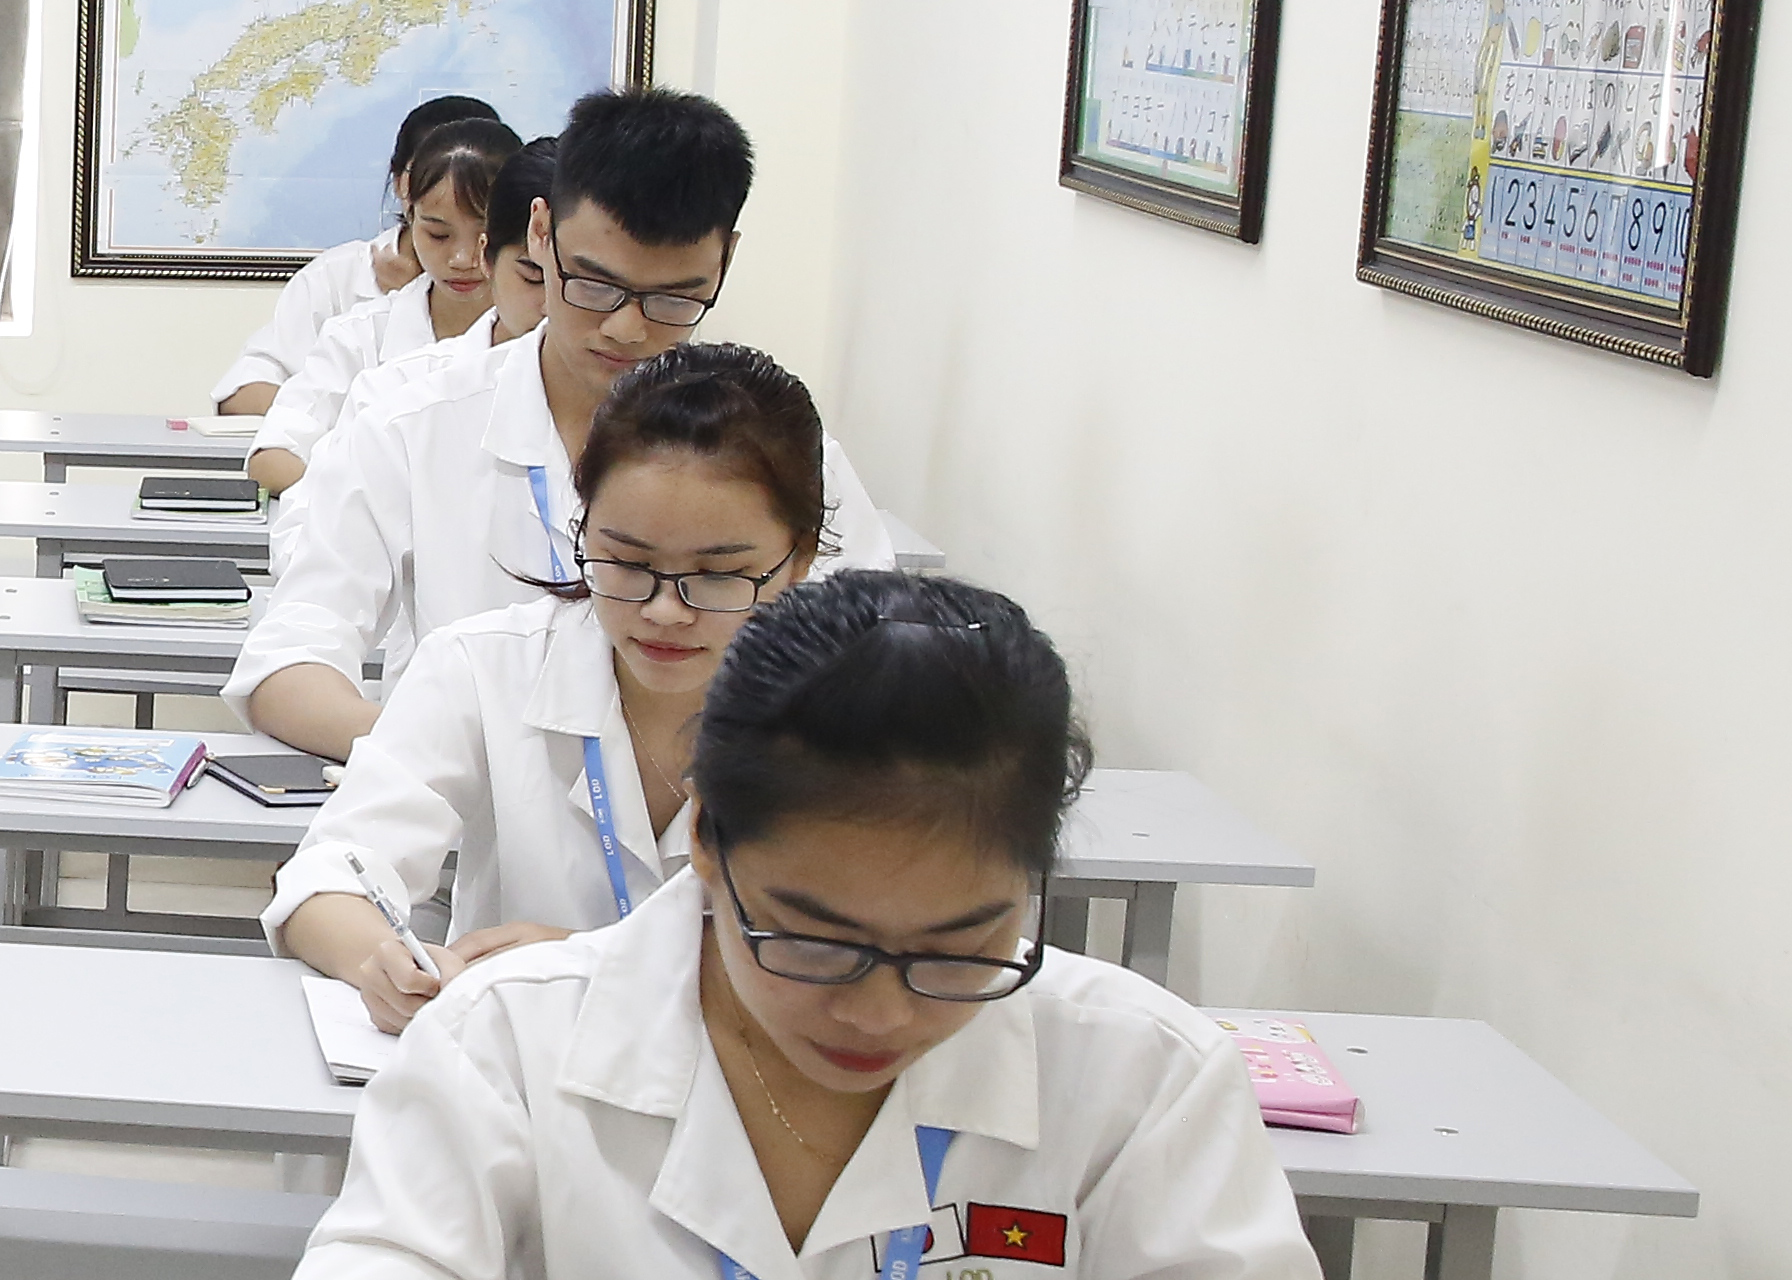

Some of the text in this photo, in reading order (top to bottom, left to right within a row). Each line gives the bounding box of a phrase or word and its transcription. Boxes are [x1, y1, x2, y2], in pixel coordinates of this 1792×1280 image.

[1504, 178, 1518, 227] 2
[1523, 181, 1537, 230] 3
[1544, 184, 1556, 235] 4
[1563, 188, 1580, 238] 5
[1584, 190, 1599, 242] 6
[1628, 198, 1644, 251] 8
[1653, 201, 1666, 255] 9
